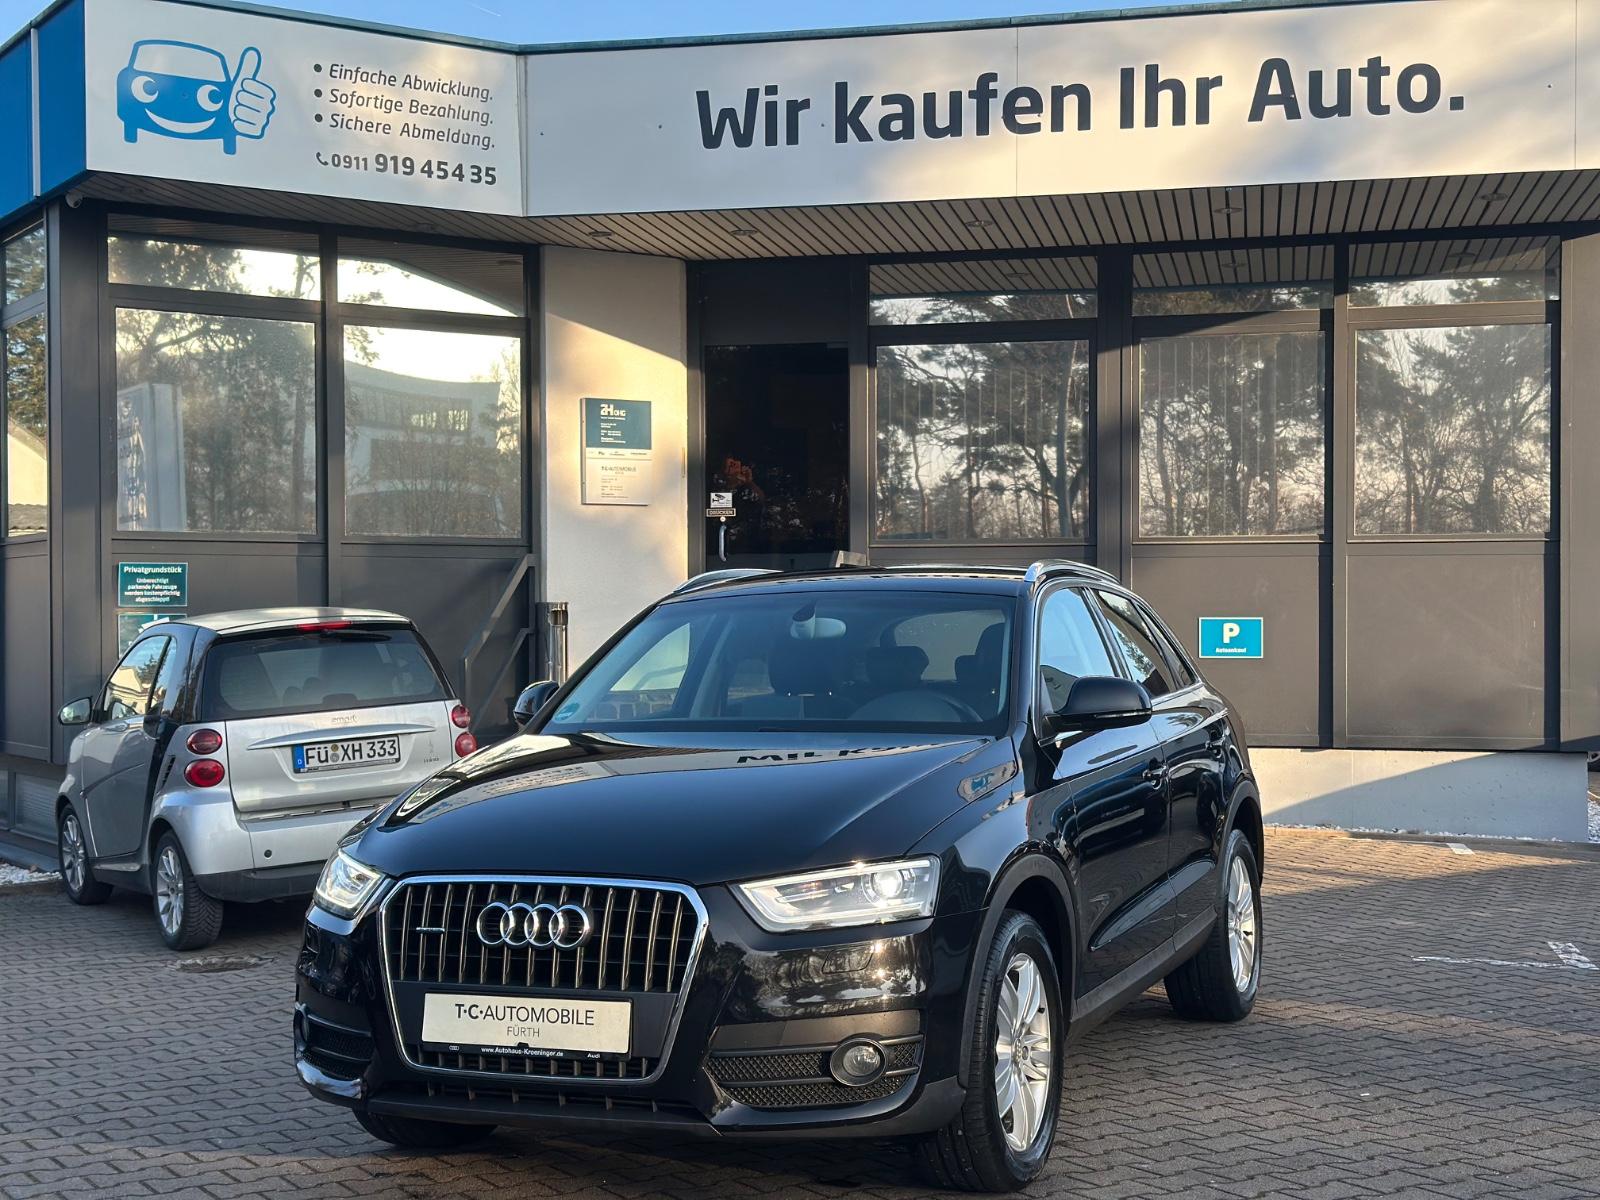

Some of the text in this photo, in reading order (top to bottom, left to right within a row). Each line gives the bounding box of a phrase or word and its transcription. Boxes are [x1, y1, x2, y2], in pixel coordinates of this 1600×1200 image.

[329, 63, 493, 103] Einfache Abwicklung.
[329, 88, 493, 126] Sofortige Bezahlung.
[696, 56, 1465, 149] Wir kaufen Ihr Auto.
[329, 113, 495, 150] Sichere Abmeldung.
[331, 153, 368, 171] 0911
[374, 153, 415, 176] 919
[124, 566, 182, 575] Privatgrundstück
[1222, 622, 1240, 644] P
[305, 746, 329, 765] FÜ
[340, 743, 363, 762] XH
[366, 739, 397, 759] 333
[506, 1024, 540, 1038] FÜRTH
